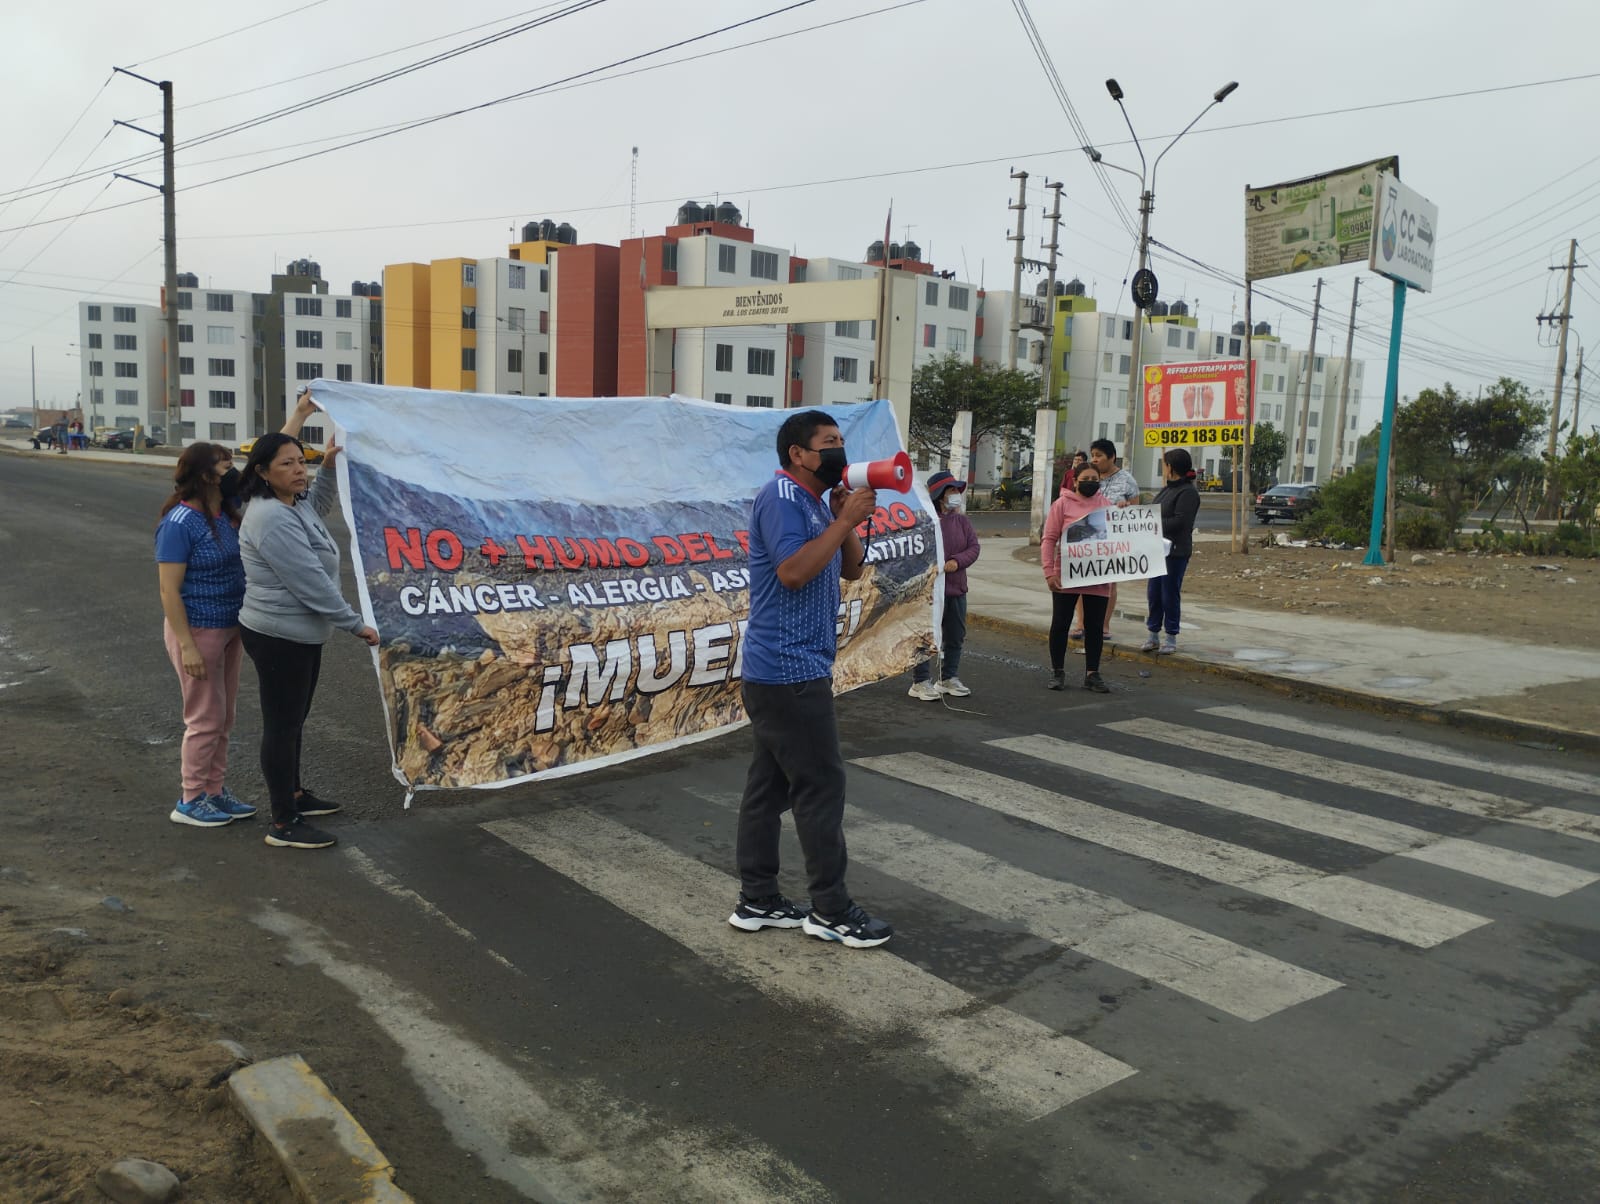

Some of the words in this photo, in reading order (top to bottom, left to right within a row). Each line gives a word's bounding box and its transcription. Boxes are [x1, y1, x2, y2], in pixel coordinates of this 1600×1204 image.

[1400, 208, 1416, 243] CC
[1397, 241, 1433, 273] LABORATORIO
[735, 292, 783, 308] BIENVENIDOS
[1161, 430, 1188, 444] 982
[1191, 428, 1217, 442] 183
[1112, 524, 1124, 534] DE
[383, 526, 464, 570] NO
[481, 537, 507, 566] +
[515, 534, 650, 569] HUMO
[651, 532, 734, 566] DEL
[1068, 543, 1093, 559] NOS
[1096, 541, 1130, 557] ESTAN
[1069, 554, 1149, 580] MATANDO
[399, 579, 545, 616] CÁNCER
[567, 574, 693, 606] ALERGIA
